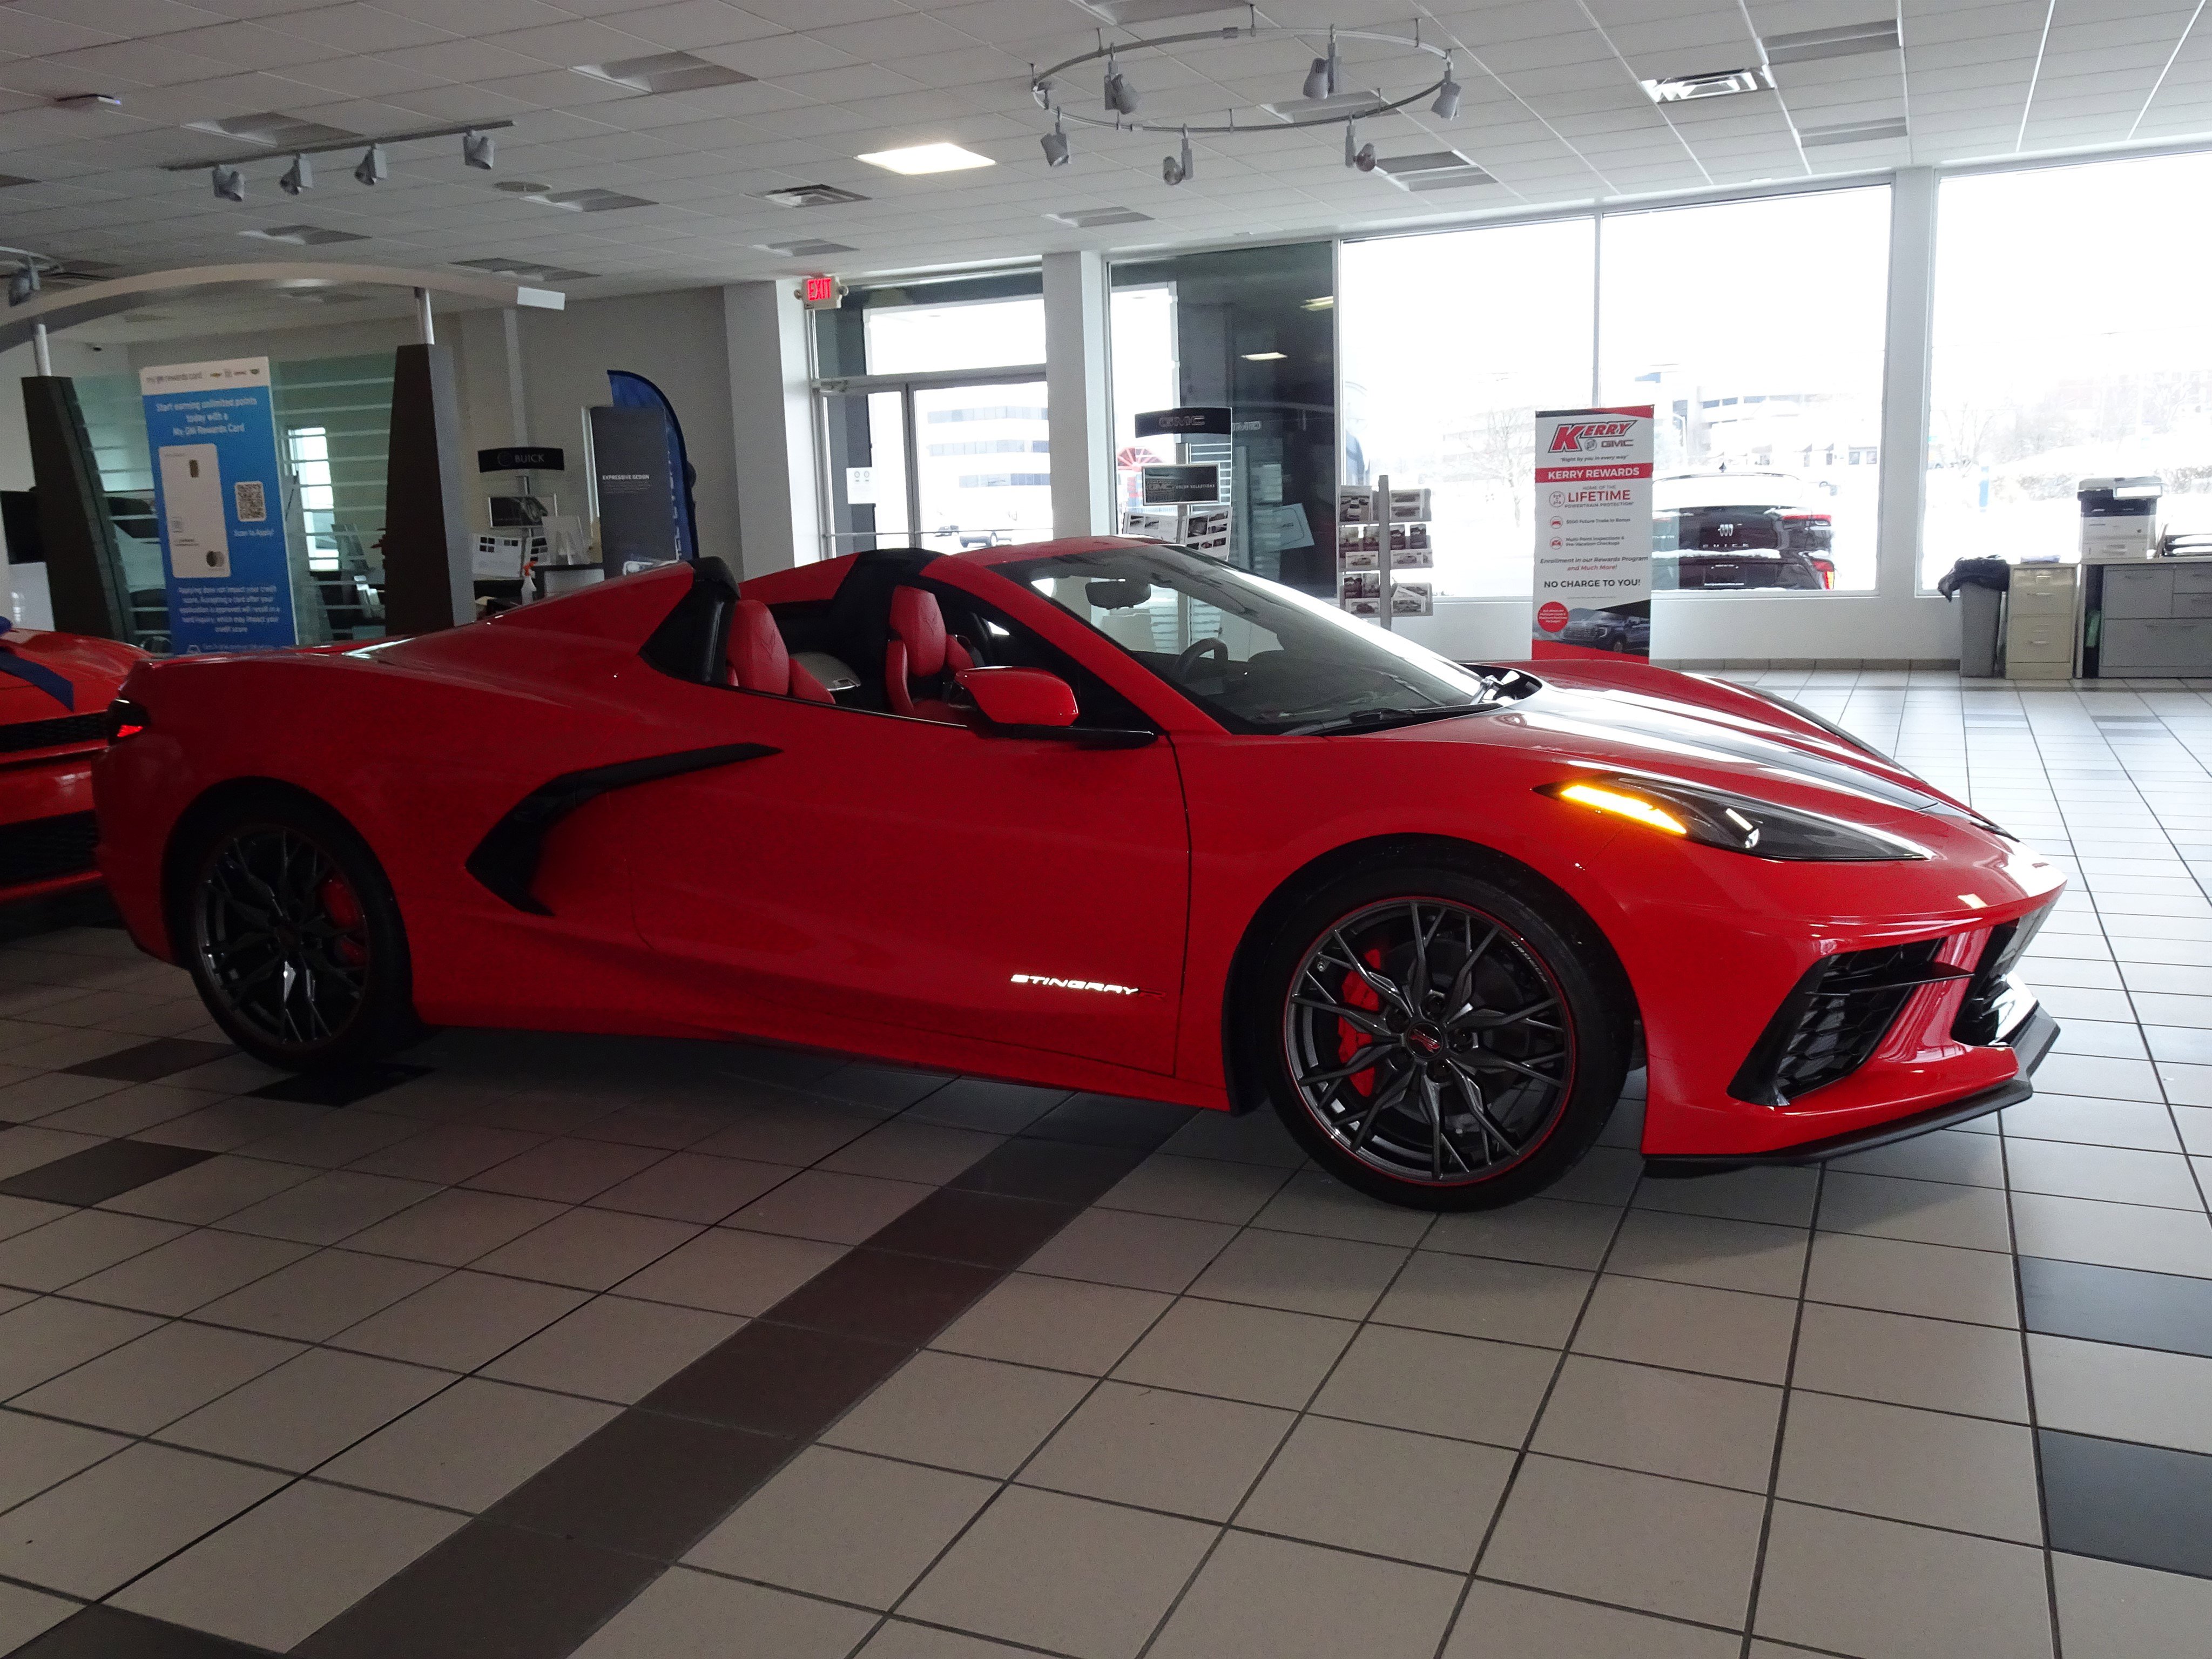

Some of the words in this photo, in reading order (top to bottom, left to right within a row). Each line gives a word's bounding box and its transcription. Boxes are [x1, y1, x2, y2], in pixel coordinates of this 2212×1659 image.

[807, 278, 832, 300] EXIT
[1159, 415, 1205, 427] GMC
[1549, 421, 1634, 452] KERRY
[1601, 440, 1634, 448] GMC
[515, 453, 545, 463] BUICK
[1548, 470, 1583, 480] KERRY
[1586, 468, 1640, 477] REWARDS
[1568, 490, 1631, 502] LIFETIME
[1010, 974, 1139, 995] STINGRAY
